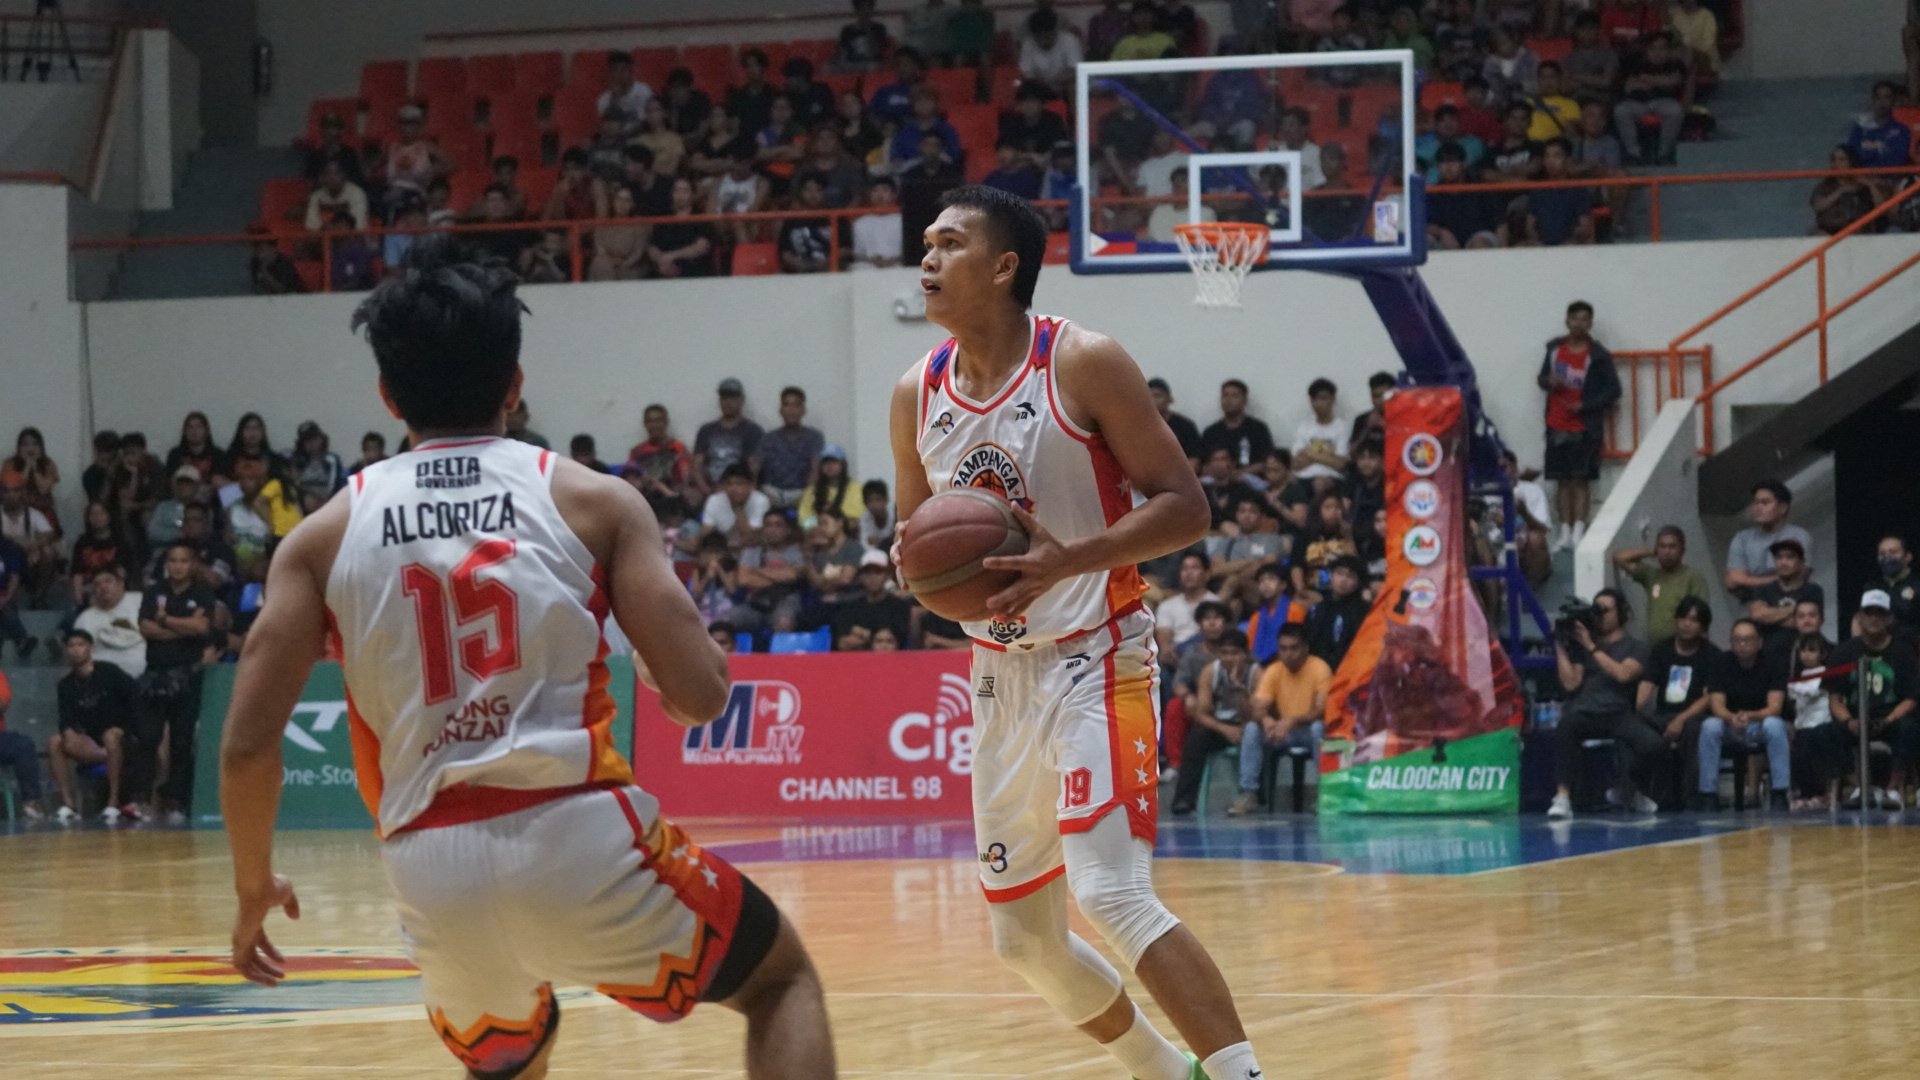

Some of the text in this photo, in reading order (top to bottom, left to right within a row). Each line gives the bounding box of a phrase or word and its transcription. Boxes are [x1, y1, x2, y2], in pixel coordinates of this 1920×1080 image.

[416, 456, 481, 477] DELTA
[382, 491, 517, 547] ALCORIZA
[401, 538, 521, 706] 15
[992, 620, 1017, 633] BGC
[1065, 659, 1081, 670] ANTA
[779, 776, 942, 801] CHANNEL 98
[1063, 767, 1092, 808] 19
[1367, 765, 1510, 791] CALOOCAN CITY
